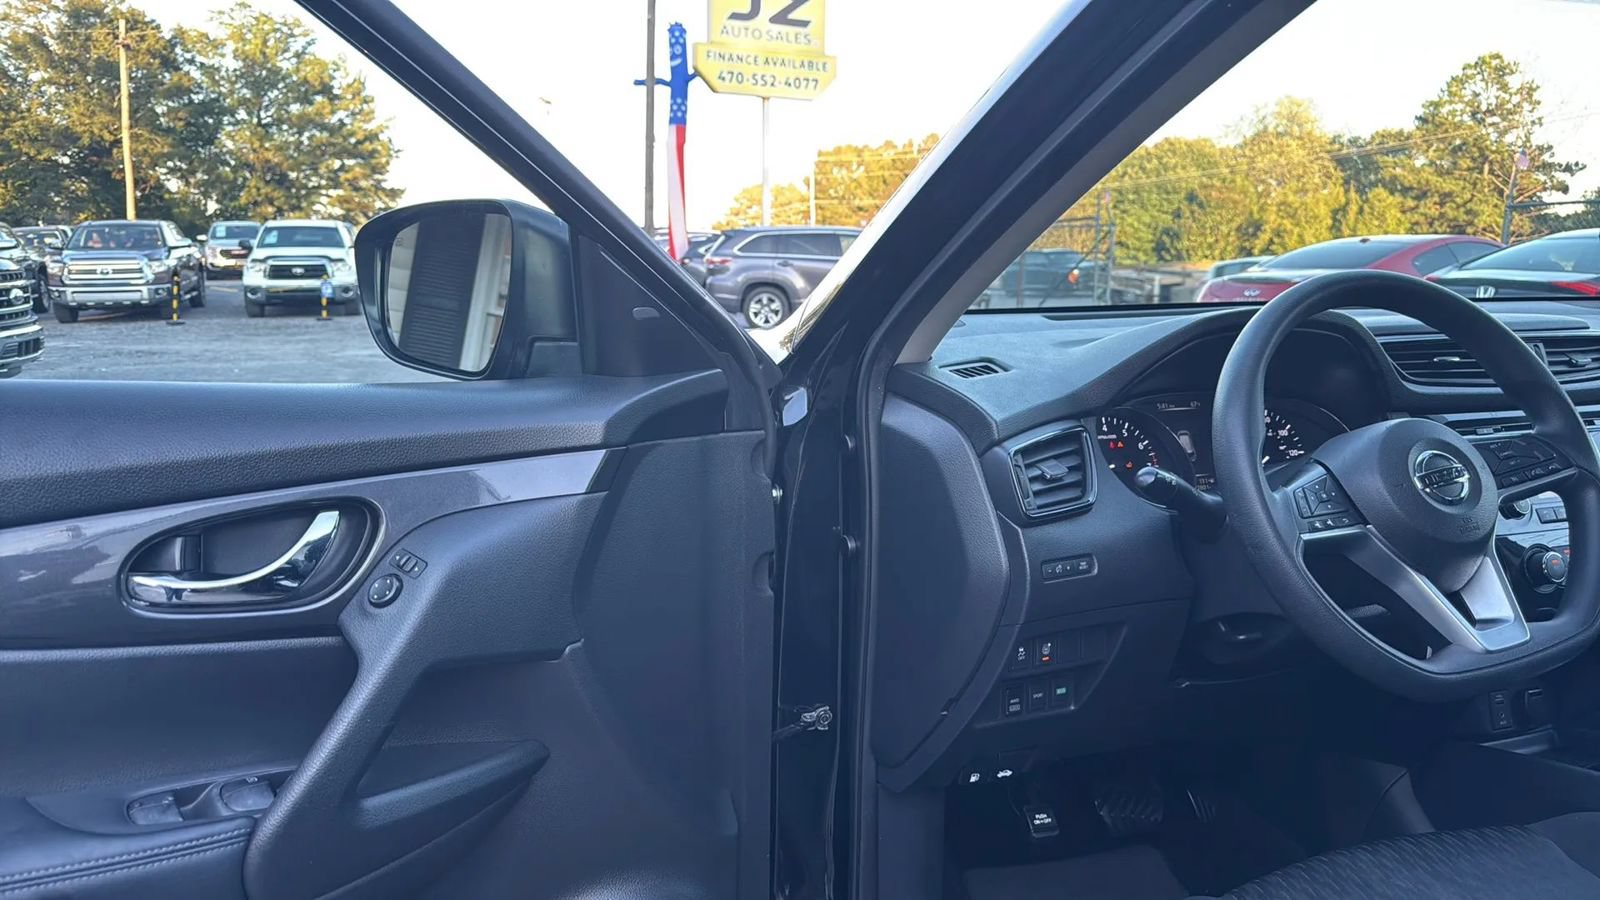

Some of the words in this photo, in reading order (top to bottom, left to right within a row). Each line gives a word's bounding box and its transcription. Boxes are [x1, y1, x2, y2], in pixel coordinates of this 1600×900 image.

[720, 25, 763, 41] AUTO
[766, 29, 812, 45] SALES
[706, 50, 759, 66] FINANCE
[763, 56, 828, 73] AVAILABLE
[1102, 424, 1108, 432] 4
[1122, 429, 1128, 437] 5
[1277, 429, 1289, 437] 100
[1138, 442, 1144, 450] 6
[1288, 449, 1299, 457] 120
